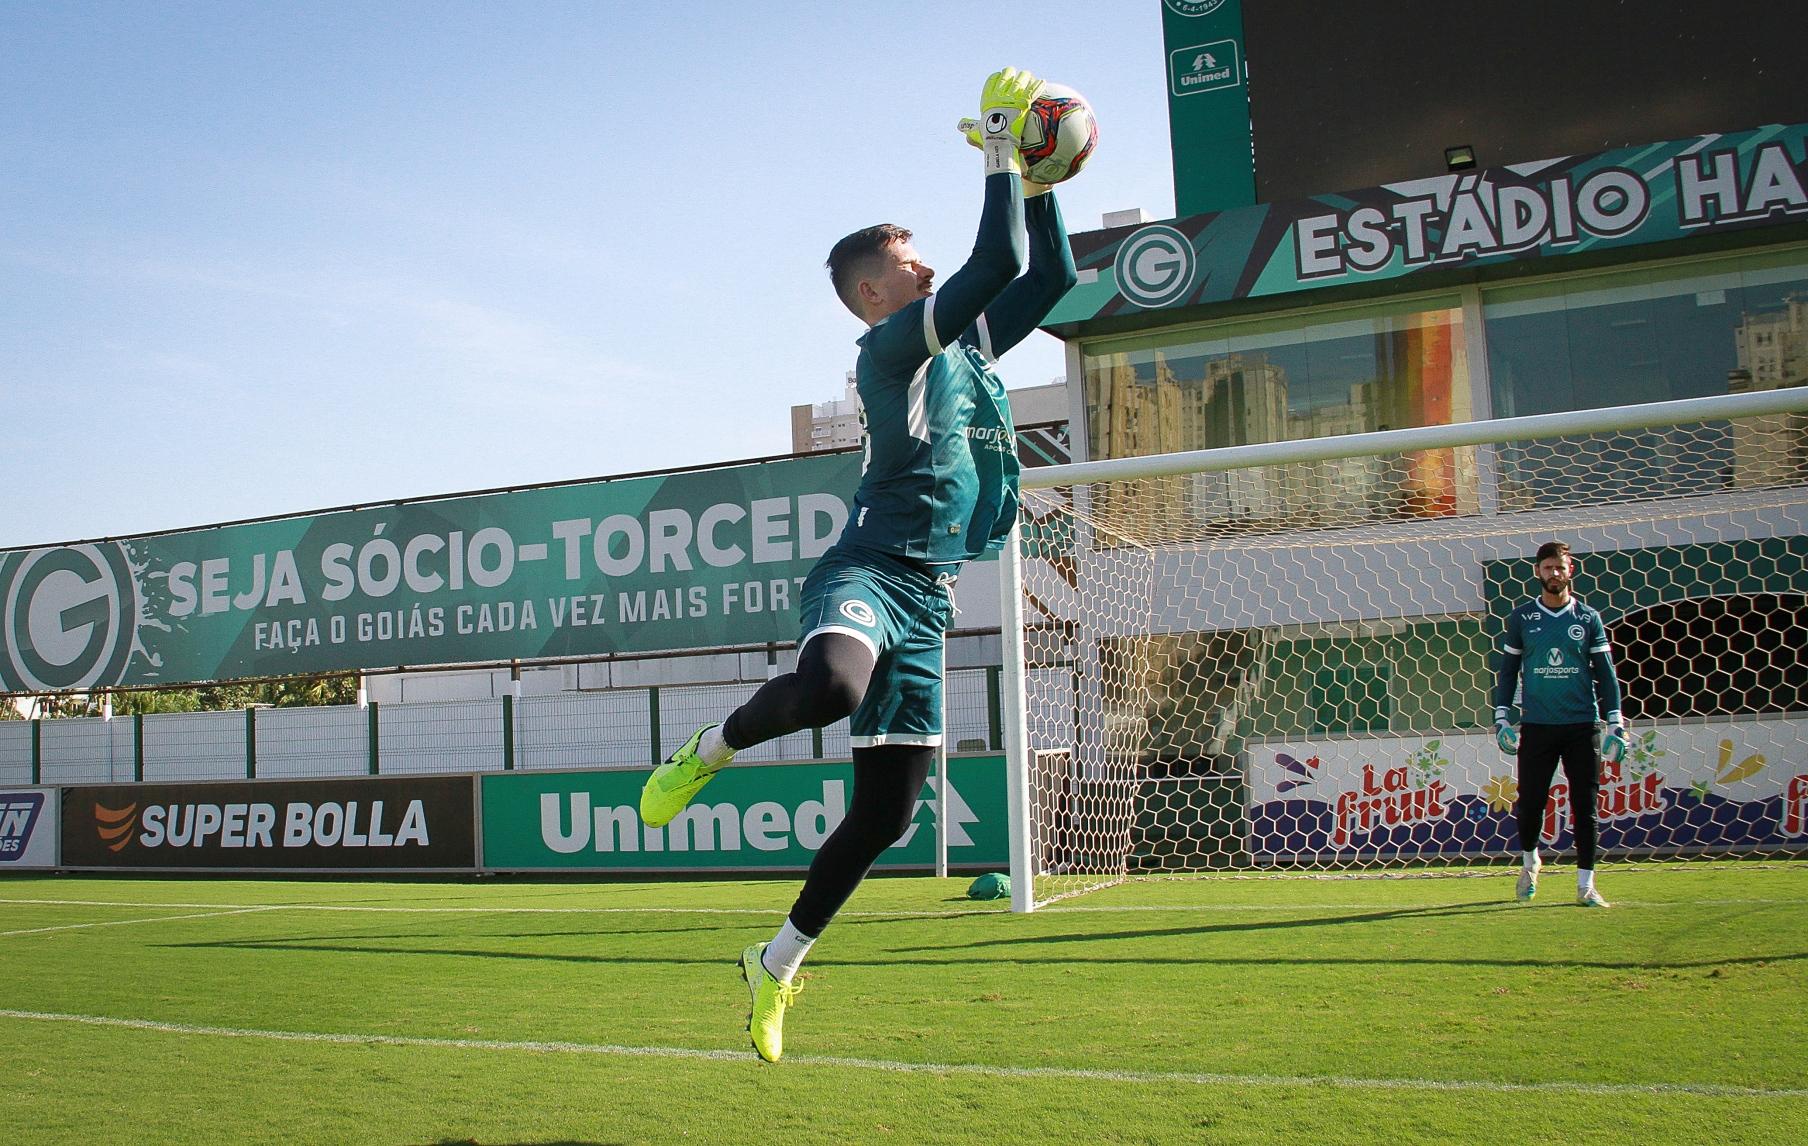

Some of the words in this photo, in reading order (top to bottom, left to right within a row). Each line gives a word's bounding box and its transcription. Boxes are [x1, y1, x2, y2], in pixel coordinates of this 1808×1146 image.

[1180, 68, 1230, 86] Unimed
[1298, 170, 1646, 275] ESTÁDIO
[1679, 146, 1808, 220] HA
[168, 550, 306, 617] SEJA
[255, 618, 321, 653] FAÇA
[330, 615, 347, 645] O
[358, 602, 445, 641] GOIÁS
[456, 599, 538, 636] CADA
[549, 594, 605, 630] VEZ
[619, 585, 709, 623] MAIS
[1333, 780, 1447, 845] fruit
[1362, 763, 1408, 797] La
[140, 803, 276, 848] SUPER
[283, 800, 430, 848] BOLLA
